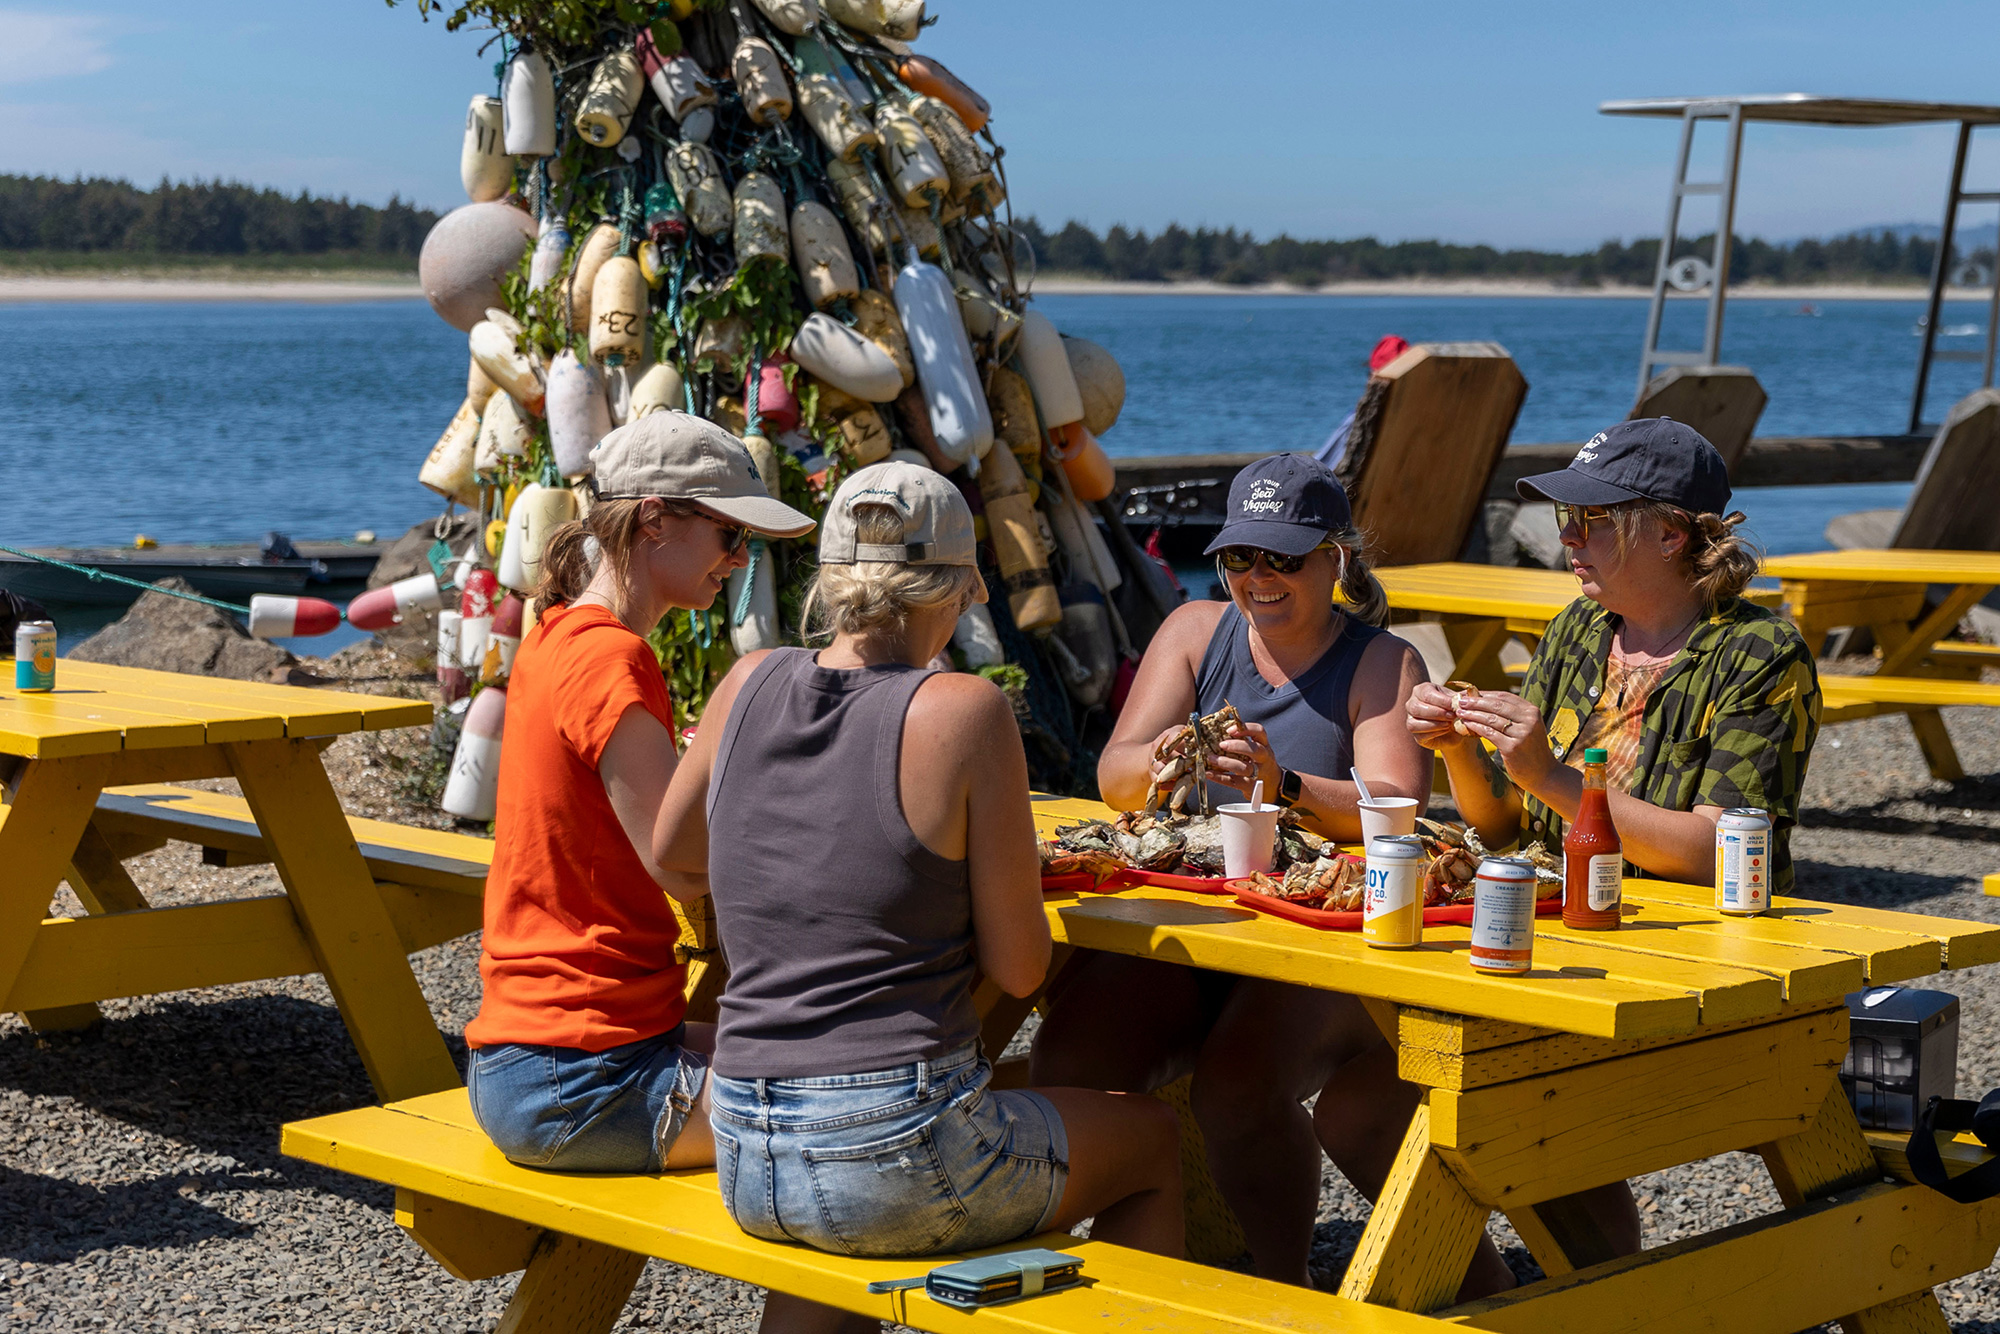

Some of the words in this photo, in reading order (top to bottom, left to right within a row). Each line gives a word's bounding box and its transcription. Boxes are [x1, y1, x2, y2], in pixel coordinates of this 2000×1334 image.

[1250, 480, 1261, 489] EAT
[1263, 478, 1280, 489] YOUR
[1251, 487, 1276, 500] Sea
[1242, 499, 1284, 513] Veggies
